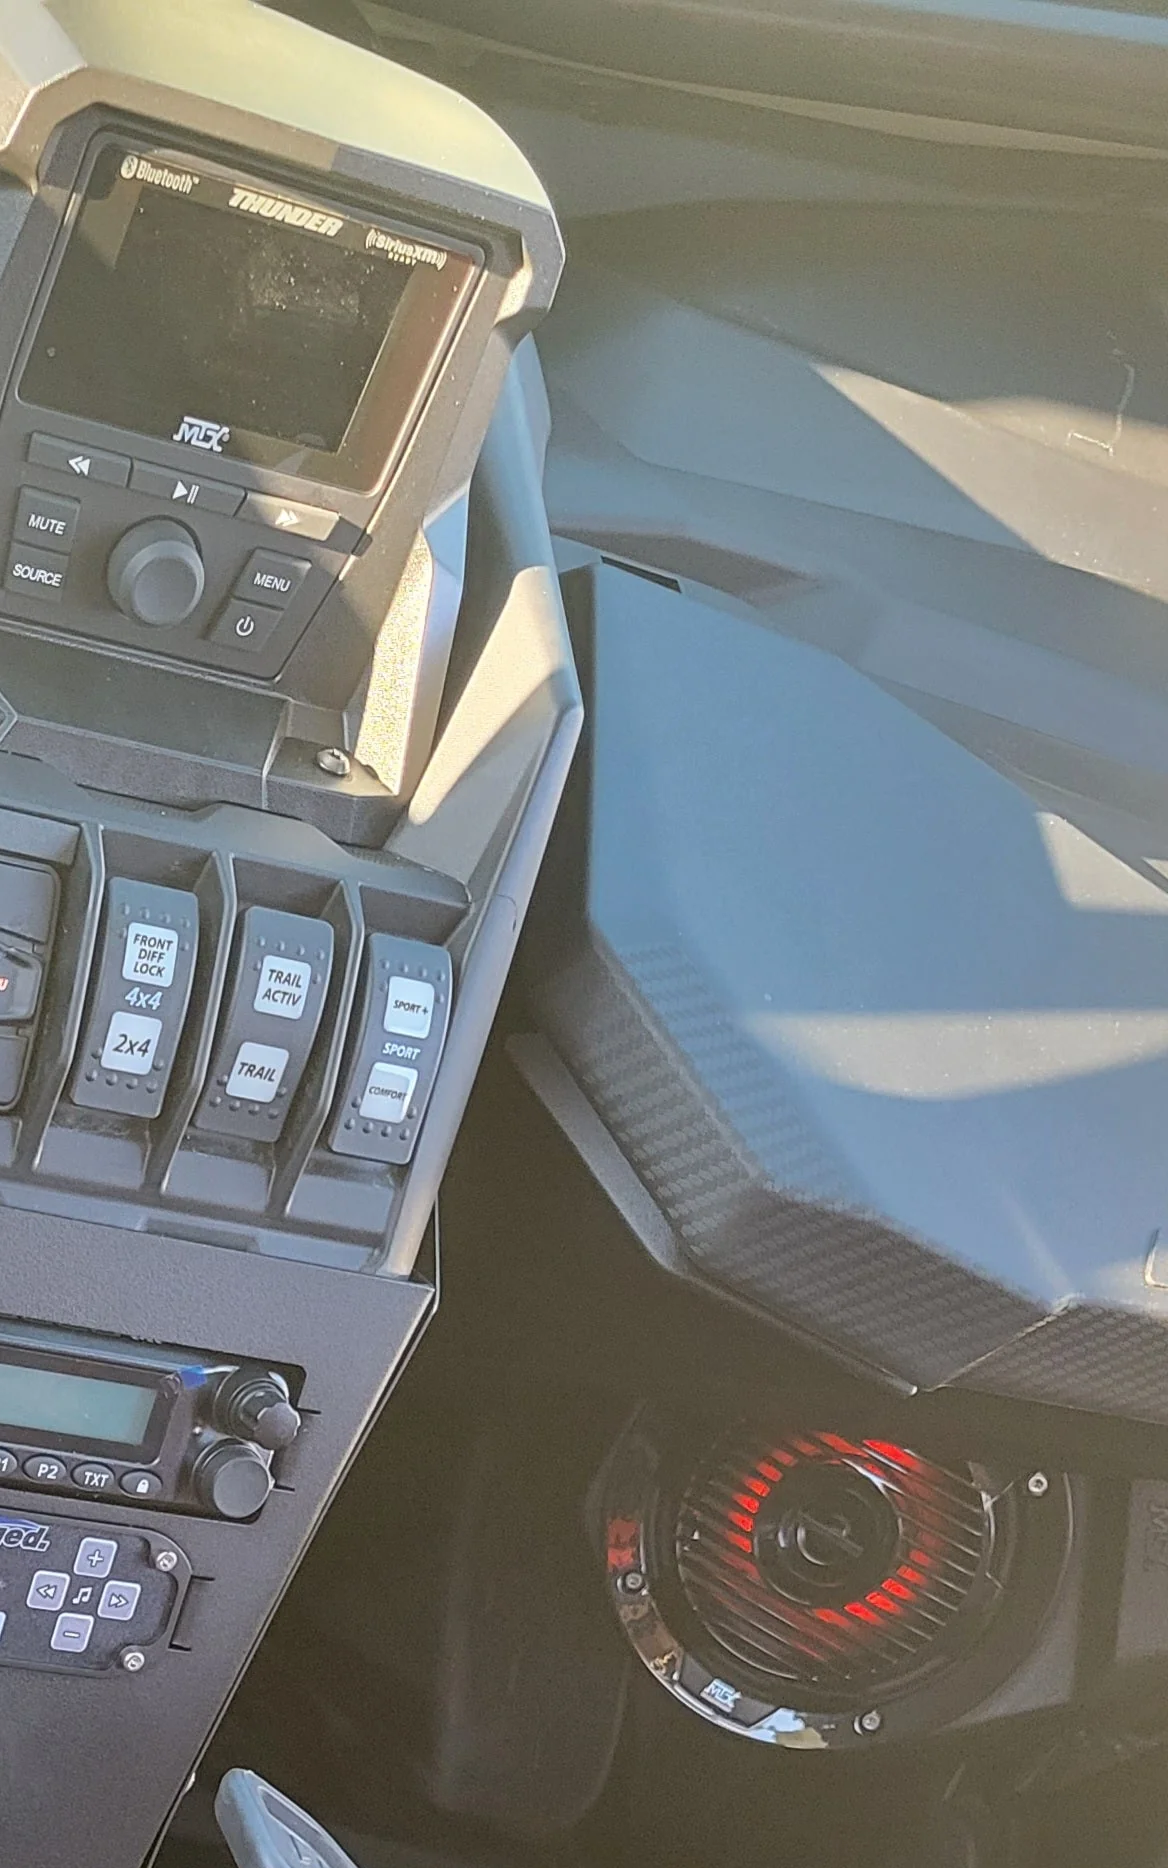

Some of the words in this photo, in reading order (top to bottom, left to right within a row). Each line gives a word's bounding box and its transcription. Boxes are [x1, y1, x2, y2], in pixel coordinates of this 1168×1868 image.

[228, 188, 344, 237] THUNDER
[173, 416, 230, 452] MTX
[28, 514, 66, 536] MUTE
[12, 563, 63, 588] SOURCE
[253, 572, 291, 593] MENU
[133, 933, 174, 951] FRONT
[137, 949, 165, 963] DIFF
[133, 961, 166, 979] LOCK
[267, 968, 303, 990] TRAIL
[124, 986, 162, 1011] 4x4
[261, 987, 303, 1008] ACTIV
[393, 999, 422, 1014] SPORT
[112, 1032, 153, 1058] 2x4
[382, 1041, 421, 1061] SPORT
[236, 1060, 277, 1083] TRAIL
[368, 1086, 408, 1101] COMFORT
[37, 1463, 59, 1480] P2
[83, 1470, 110, 1488] TXT
